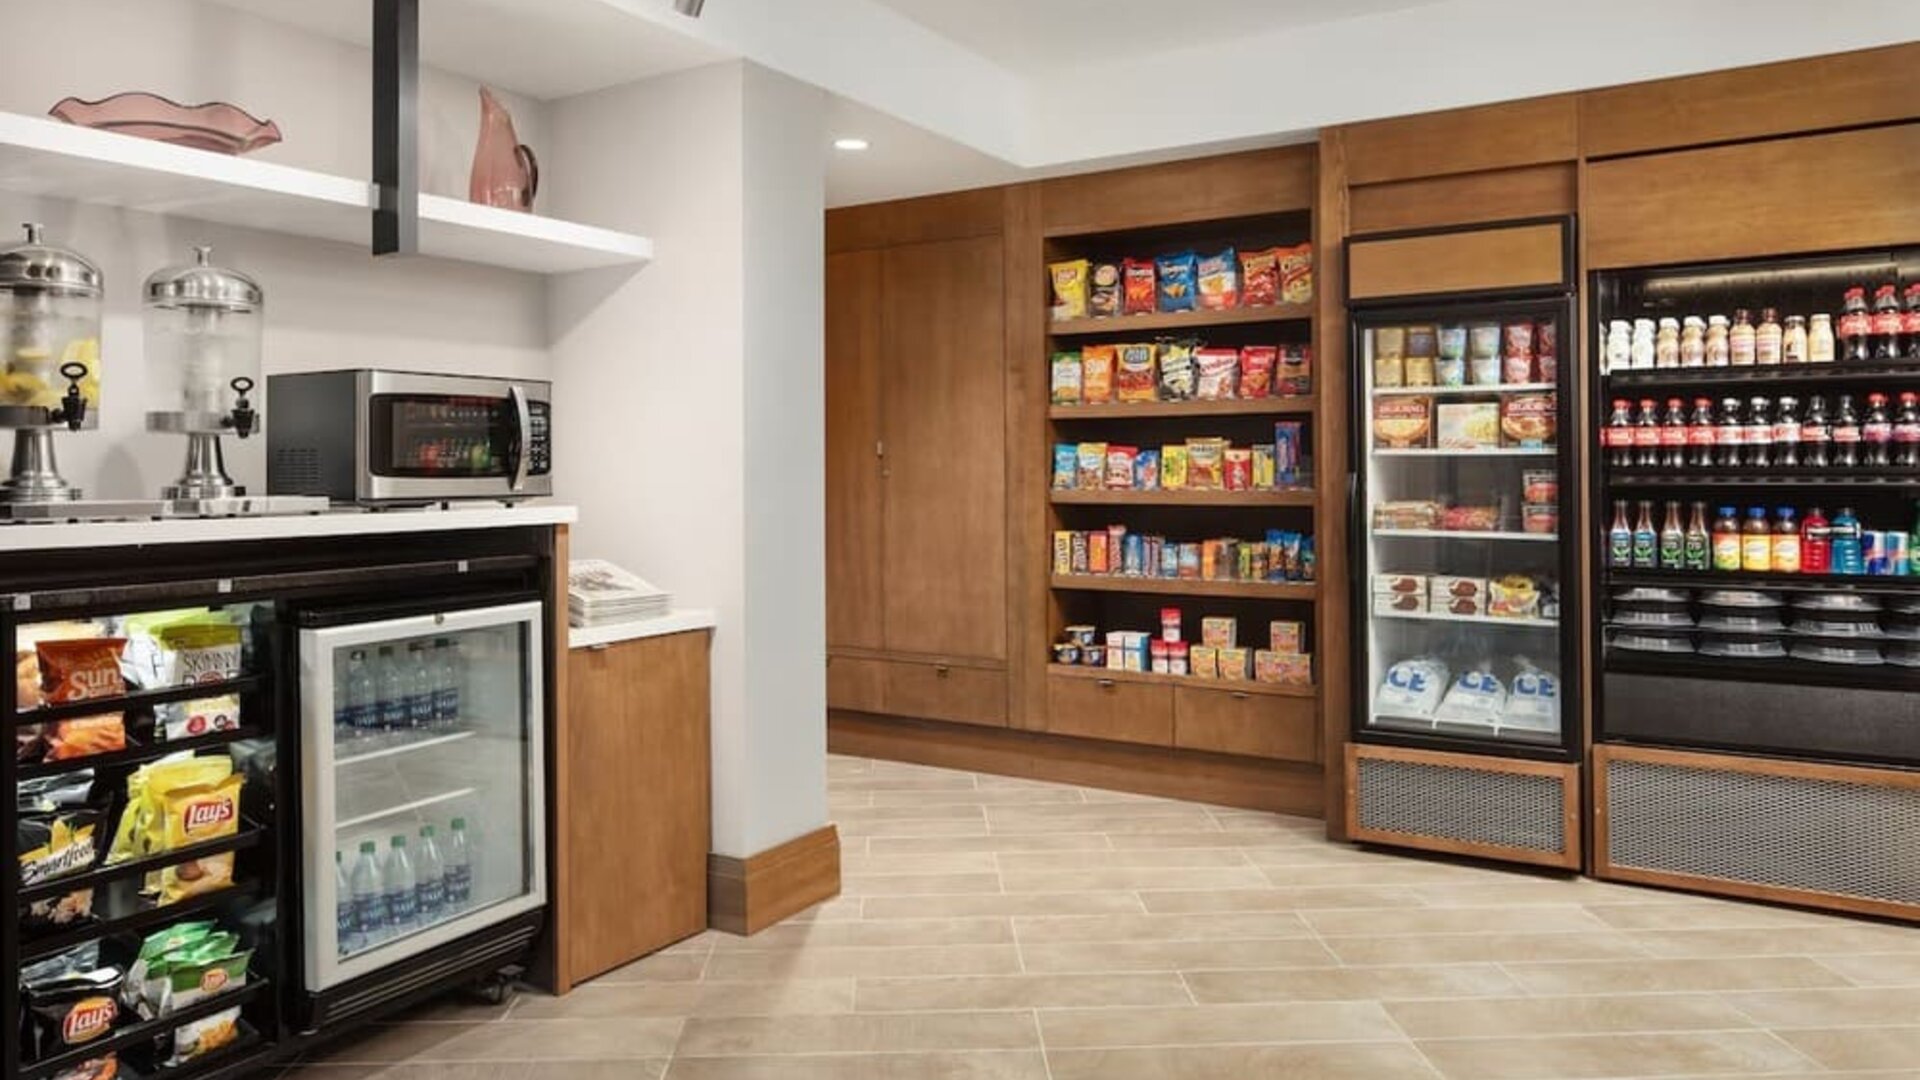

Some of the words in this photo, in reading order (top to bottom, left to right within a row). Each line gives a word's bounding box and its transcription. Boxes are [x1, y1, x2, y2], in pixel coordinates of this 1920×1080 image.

[68, 668, 118, 700] Sun
[187, 799, 231, 830] Lay's
[69, 1003, 114, 1038] Lay's
